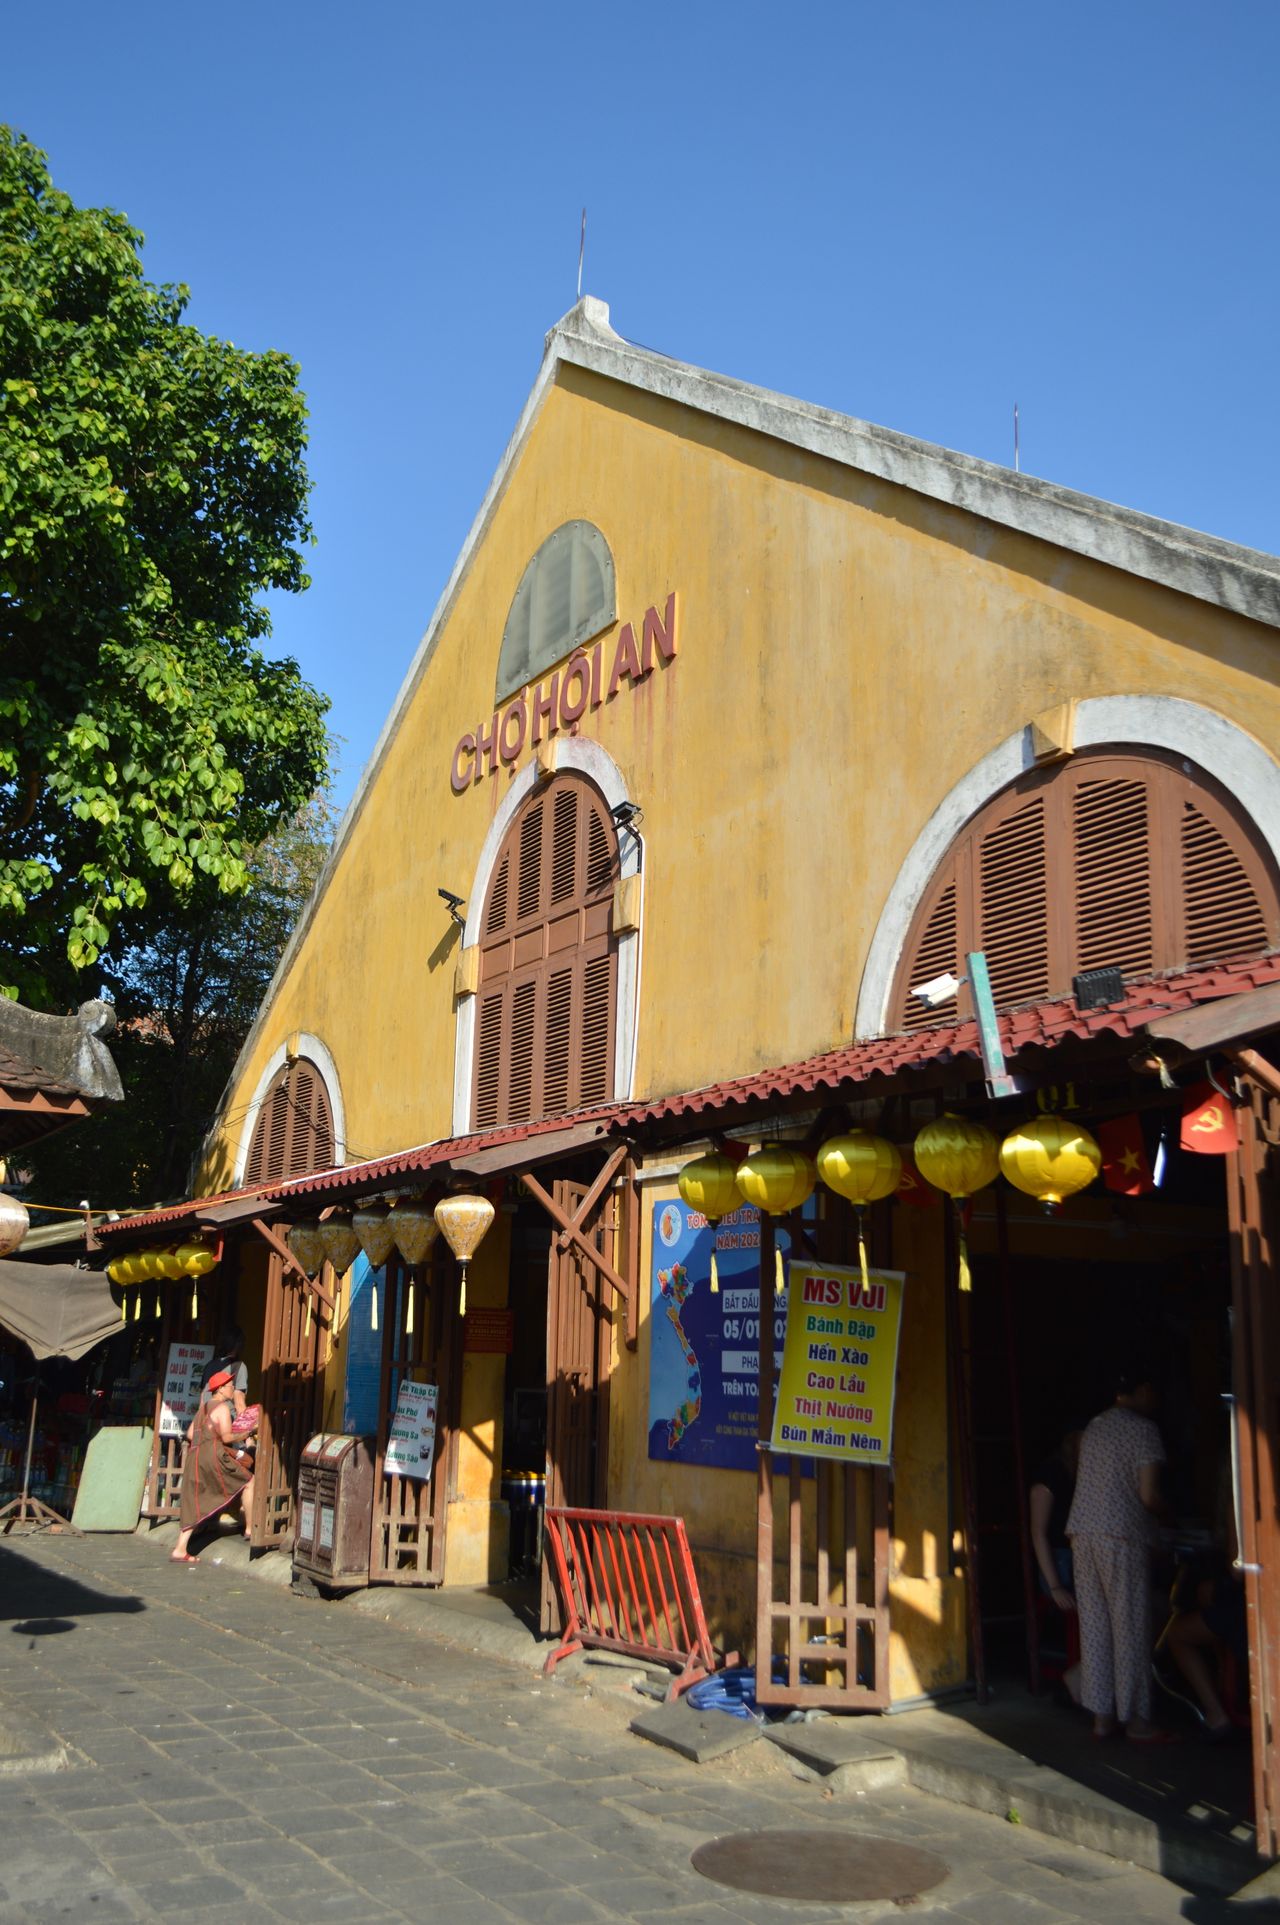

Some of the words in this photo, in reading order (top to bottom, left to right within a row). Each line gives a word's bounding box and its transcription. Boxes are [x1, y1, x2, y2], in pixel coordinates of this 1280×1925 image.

[451, 685, 529, 791] CHỢ
[531, 642, 603, 745] HỘI
[608, 592, 678, 697] AN
[740, 1232, 760, 1249] 202
[804, 1278, 841, 1304] MS
[848, 1283, 884, 1309] VUI
[807, 1316, 842, 1334] Bánh
[848, 1320, 875, 1340] Đập
[741, 1355, 759, 1372] PHẠ
[808, 1342, 836, 1361] Hến
[841, 1347, 868, 1365] Xào
[722, 1379, 744, 1396] TRÊN
[807, 1372, 834, 1389] Cao
[840, 1373, 865, 1393] Lầu
[795, 1398, 821, 1419] Thịt
[826, 1402, 873, 1423] Nướng
[781, 1425, 807, 1442] Bún
[811, 1427, 845, 1446] Mắm
[850, 1433, 881, 1450] Nêm
